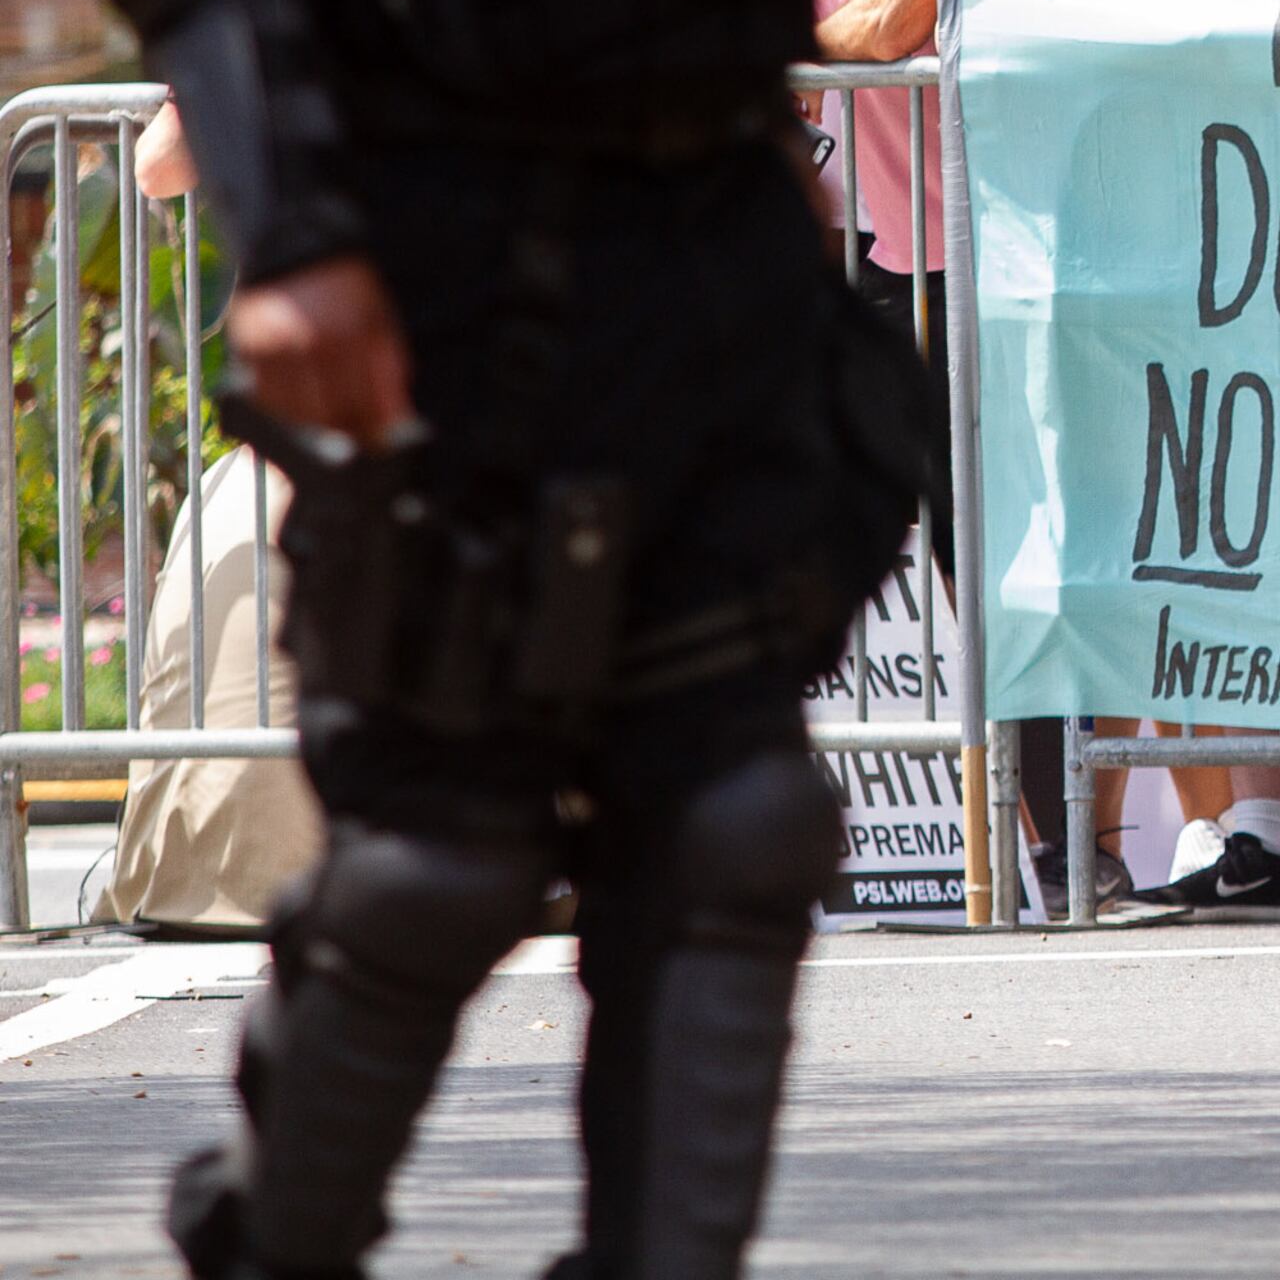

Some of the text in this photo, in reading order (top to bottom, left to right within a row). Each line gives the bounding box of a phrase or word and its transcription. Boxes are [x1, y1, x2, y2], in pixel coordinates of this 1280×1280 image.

[1132, 361, 1275, 570] NO
[800, 653, 949, 700] GANST
[838, 822, 966, 859] PREMA
[853, 878, 968, 905] PSLWEB.O
